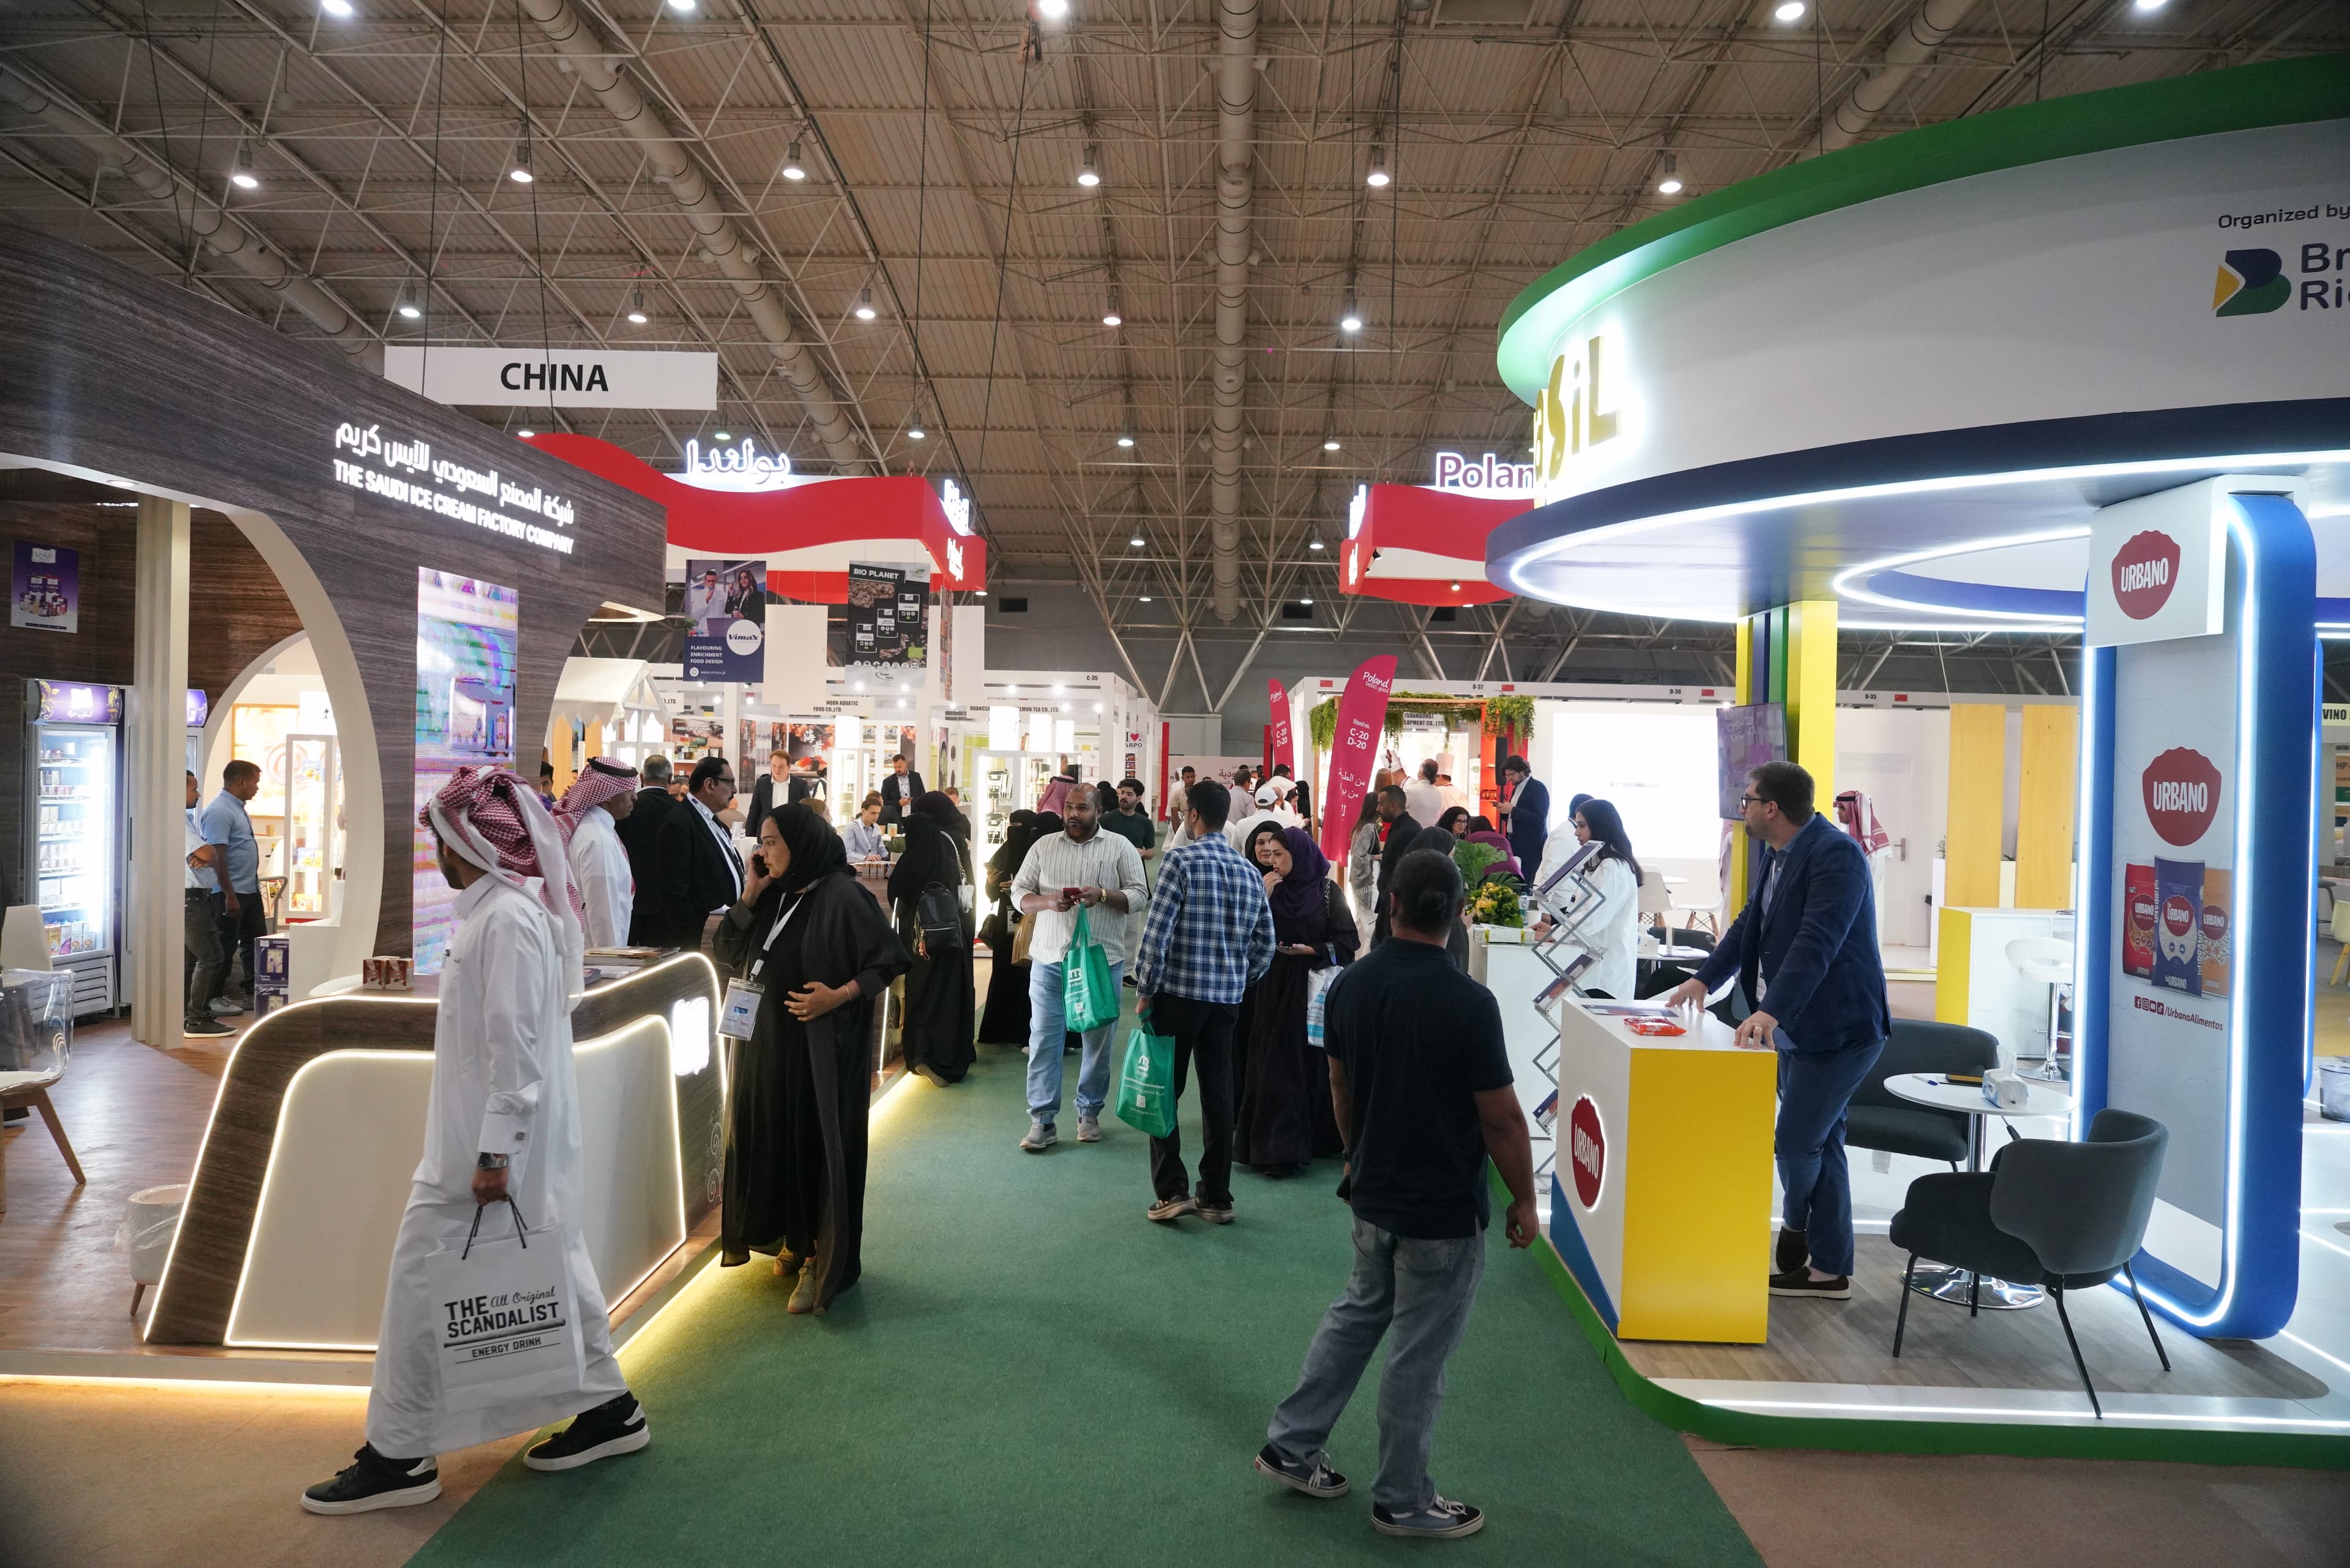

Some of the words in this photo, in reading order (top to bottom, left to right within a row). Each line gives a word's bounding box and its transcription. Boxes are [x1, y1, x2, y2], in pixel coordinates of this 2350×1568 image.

[2218, 206, 2319, 229] Organized
[2326, 204, 2350, 220] by
[2300, 278, 2350, 310] Ri
[501, 363, 609, 392] CHINA
[335, 423, 381, 457] كريم
[687, 438, 791, 484] بولندا
[1438, 454, 1534, 488] Polan
[433, 460, 498, 497] السعودي
[334, 459, 364, 488] THE
[365, 470, 409, 502] SAUDI
[410, 485, 432, 510] ICE
[433, 493, 477, 524] CREAM
[477, 508, 526, 539] FACTORY
[526, 524, 574, 554] COMPANY
[499, 482, 542, 513] المصنع
[543, 495, 574, 526] شركة
[869, 570, 899, 580] PLANET
[2121, 558, 2169, 592] URBANO
[1363, 671, 1389, 688] Poland
[1353, 719, 1364, 728] Stand
[2323, 709, 2346, 720] VINO
[1276, 727, 1287, 738] C-20
[1277, 736, 1288, 747] D-20
[1347, 737, 1367, 750] D-20
[1350, 728, 1369, 741] C-20
[2154, 782, 2208, 813] URBANO
[2135, 903, 2154, 916] URBANO
[2167, 908, 2189, 923] URBANO
[2203, 913, 2225, 927] URBANO
[2169, 976, 2187, 989] URBANO
[2165, 1006, 2223, 1031] /UrbanoAlimentos
[1574, 1123, 1599, 1179] URBANO
[444, 1296, 489, 1320] THE
[491, 1294, 508, 1308] All
[513, 1285, 556, 1304] Original
[447, 1302, 559, 1338] SCANDALIST
[472, 1343, 510, 1357] ENERGY
[513, 1337, 542, 1350] DRINK
